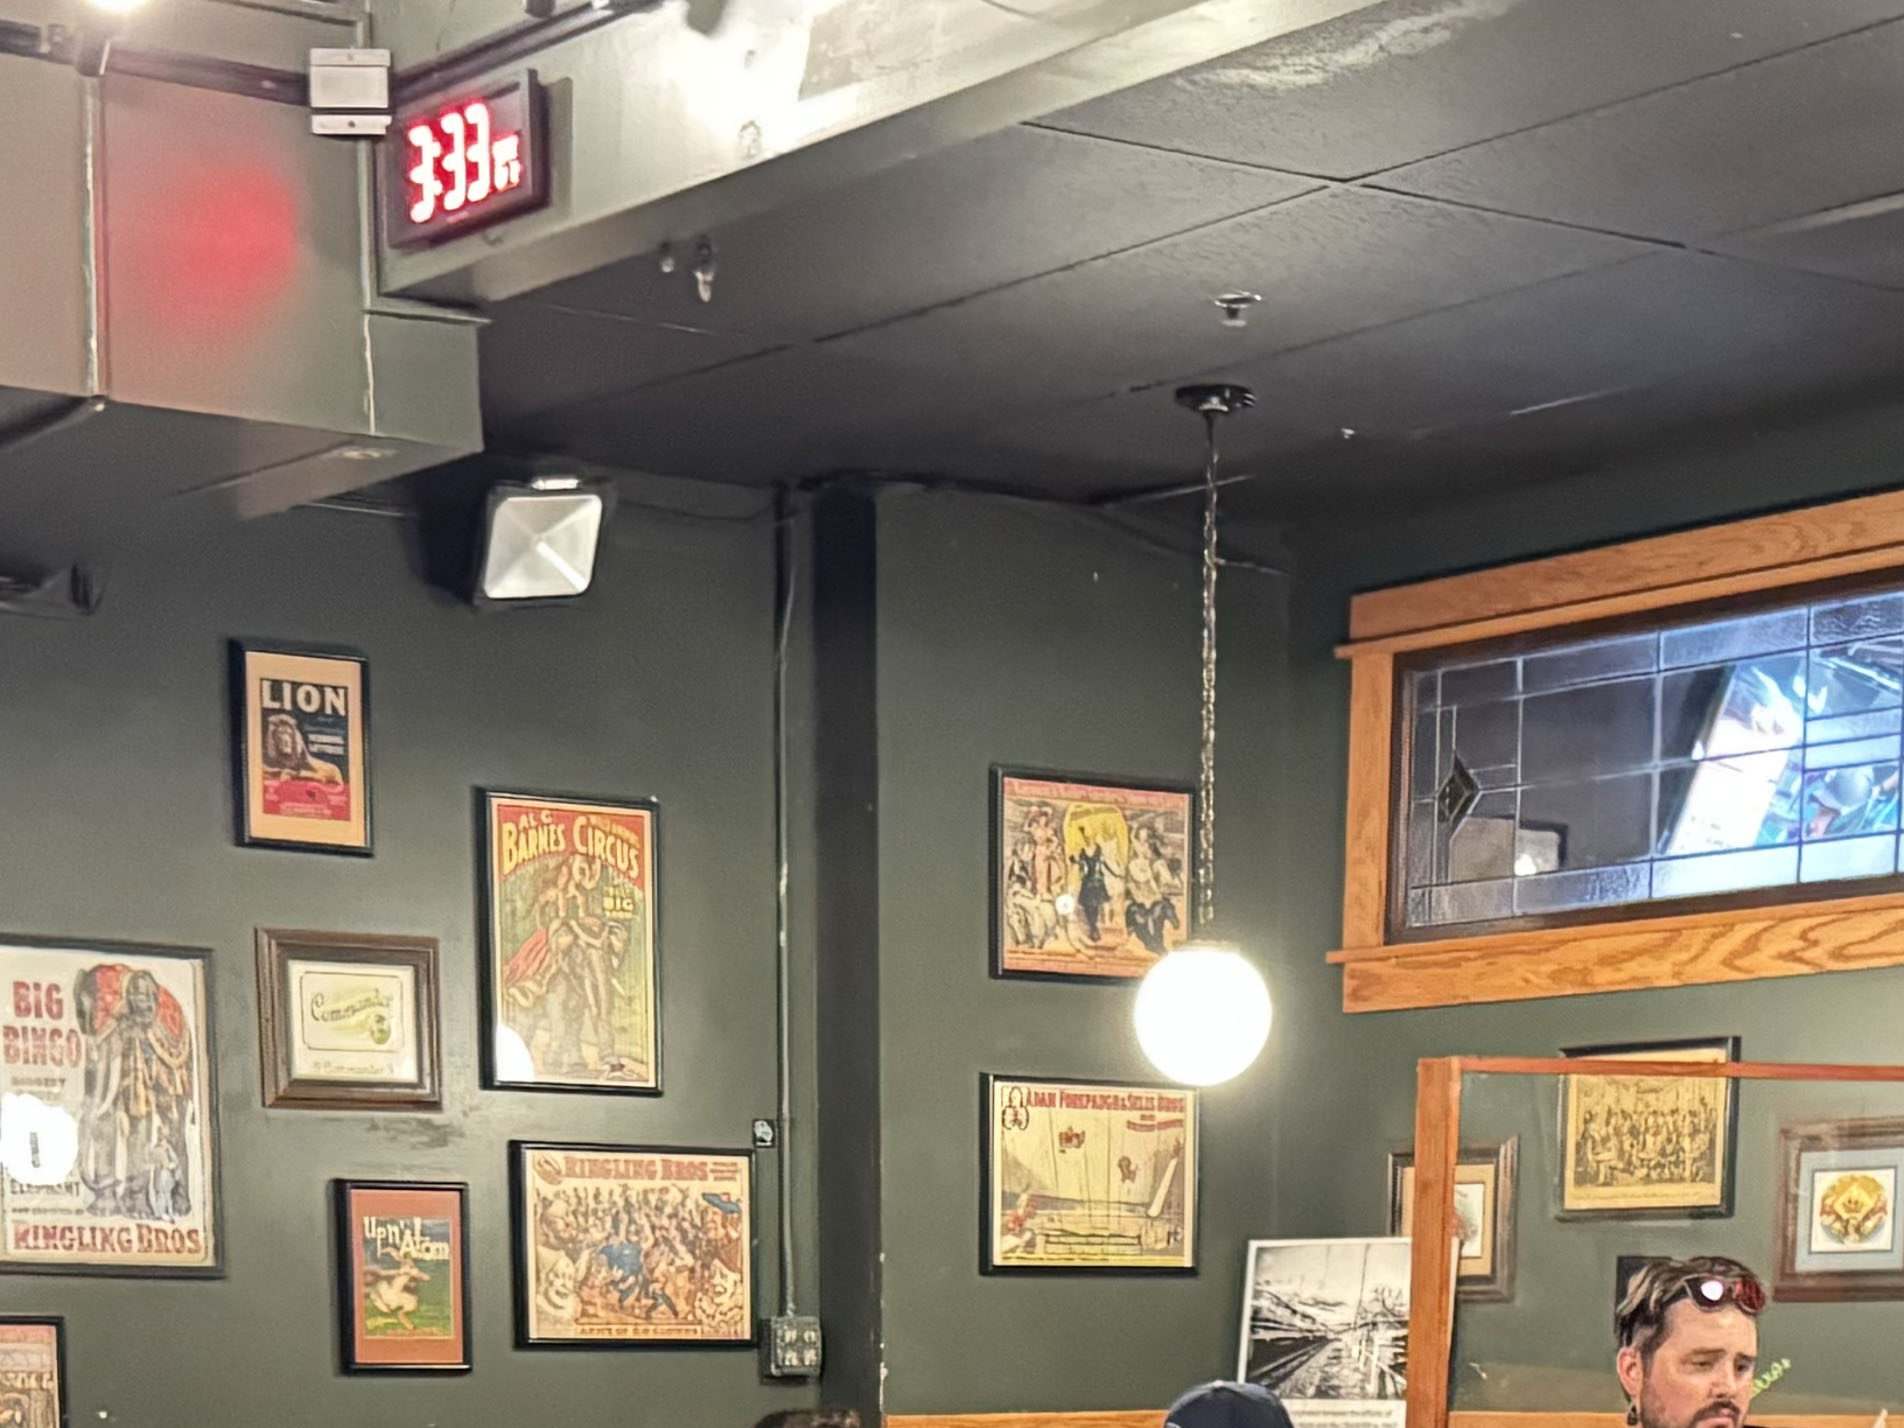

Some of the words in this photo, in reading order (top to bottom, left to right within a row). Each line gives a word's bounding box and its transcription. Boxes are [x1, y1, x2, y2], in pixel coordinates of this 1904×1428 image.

[261, 680, 346, 717] LION
[501, 821, 566, 876] BARNES
[573, 815, 640, 879] CIRCUS
[3, 1025, 83, 1068] BINGO
[564, 1156, 657, 1180] RINGLING
[660, 1159, 709, 1181] BROS
[14, 1223, 132, 1253] RINGLING
[136, 1223, 200, 1255] BROS
[399, 1217, 451, 1261] Atom
